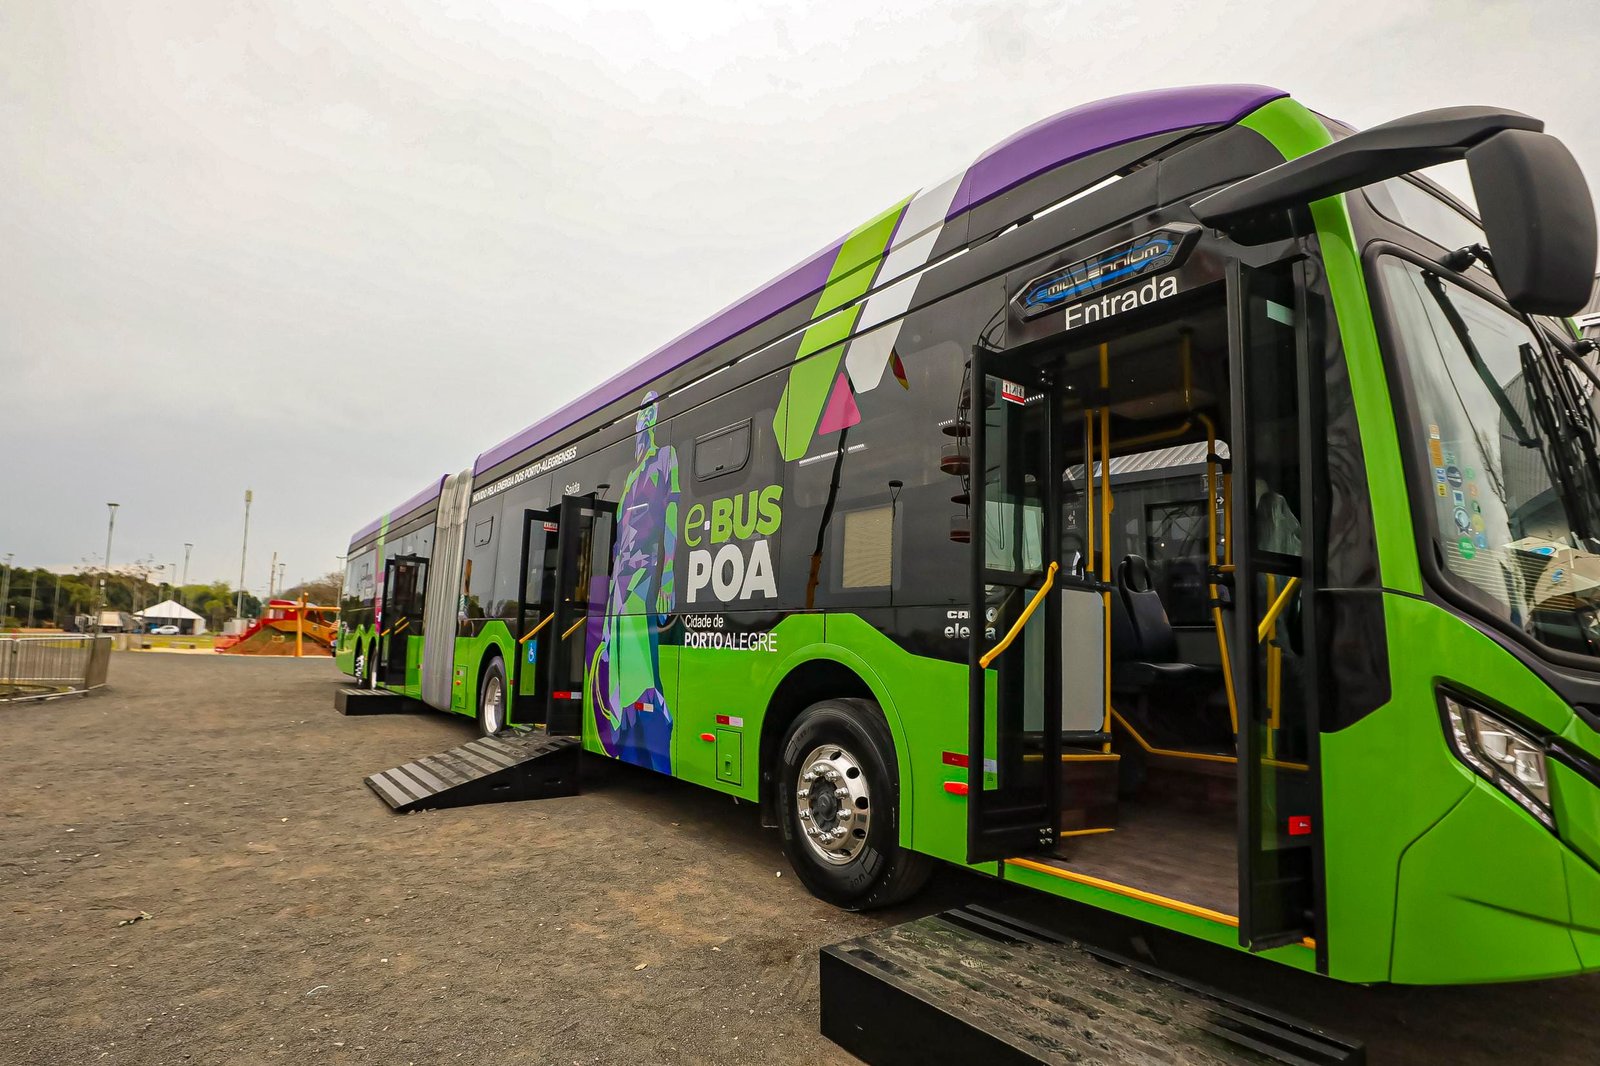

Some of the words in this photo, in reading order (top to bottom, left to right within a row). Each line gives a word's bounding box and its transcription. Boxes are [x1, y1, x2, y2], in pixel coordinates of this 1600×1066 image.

[1065, 275, 1177, 330] Entrada
[487, 483, 497, 496] PELA
[497, 475, 514, 492] ENERGIA
[515, 471, 525, 484] DOS
[564, 482, 580, 495] Saída
[686, 540, 778, 603] POA
[685, 614, 712, 628] Cidade
[713, 614, 724, 626] de
[684, 632, 723, 649] PORTO
[724, 632, 778, 652] ALEGRE
